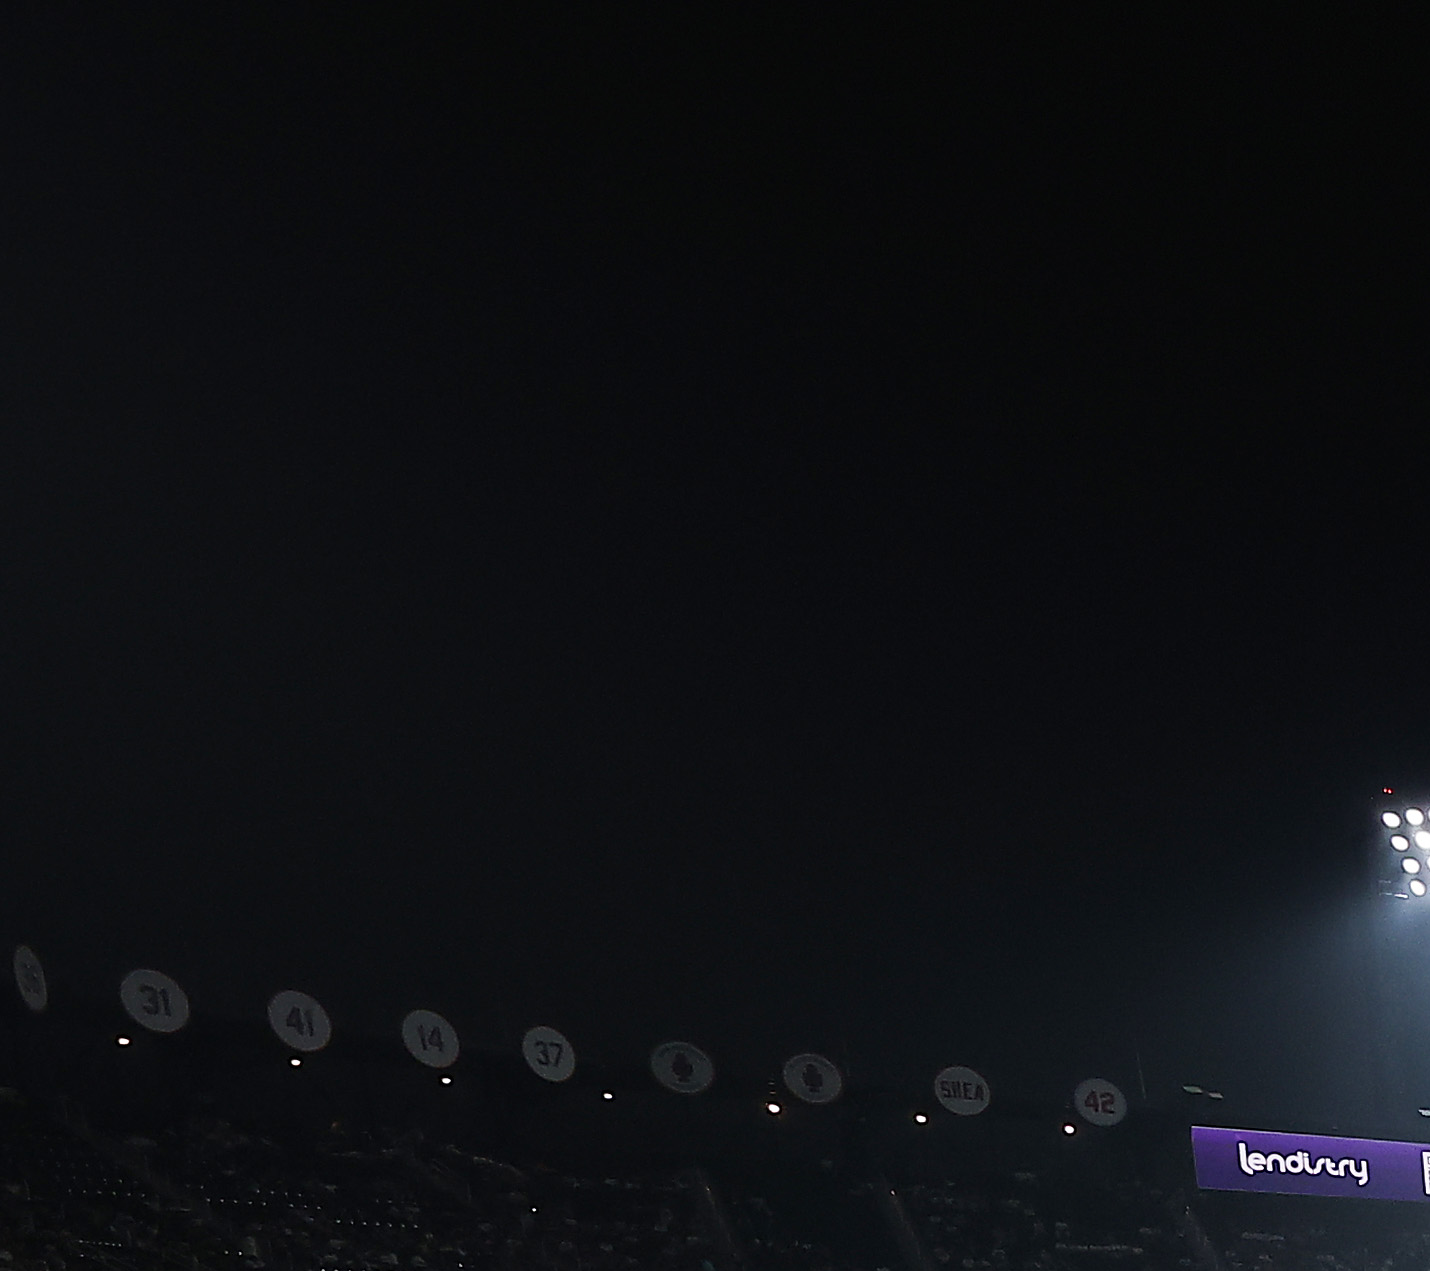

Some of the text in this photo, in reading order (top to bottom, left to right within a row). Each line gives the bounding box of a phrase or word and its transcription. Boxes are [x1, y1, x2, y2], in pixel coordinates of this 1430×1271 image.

[140, 984, 171, 1018] 31
[286, 1006, 315, 1038] 41
[418, 1023, 444, 1053] 14
[533, 1040, 562, 1068] 37
[1083, 1090, 1116, 1115] 42
[1239, 1142, 1369, 1185] lendistry
